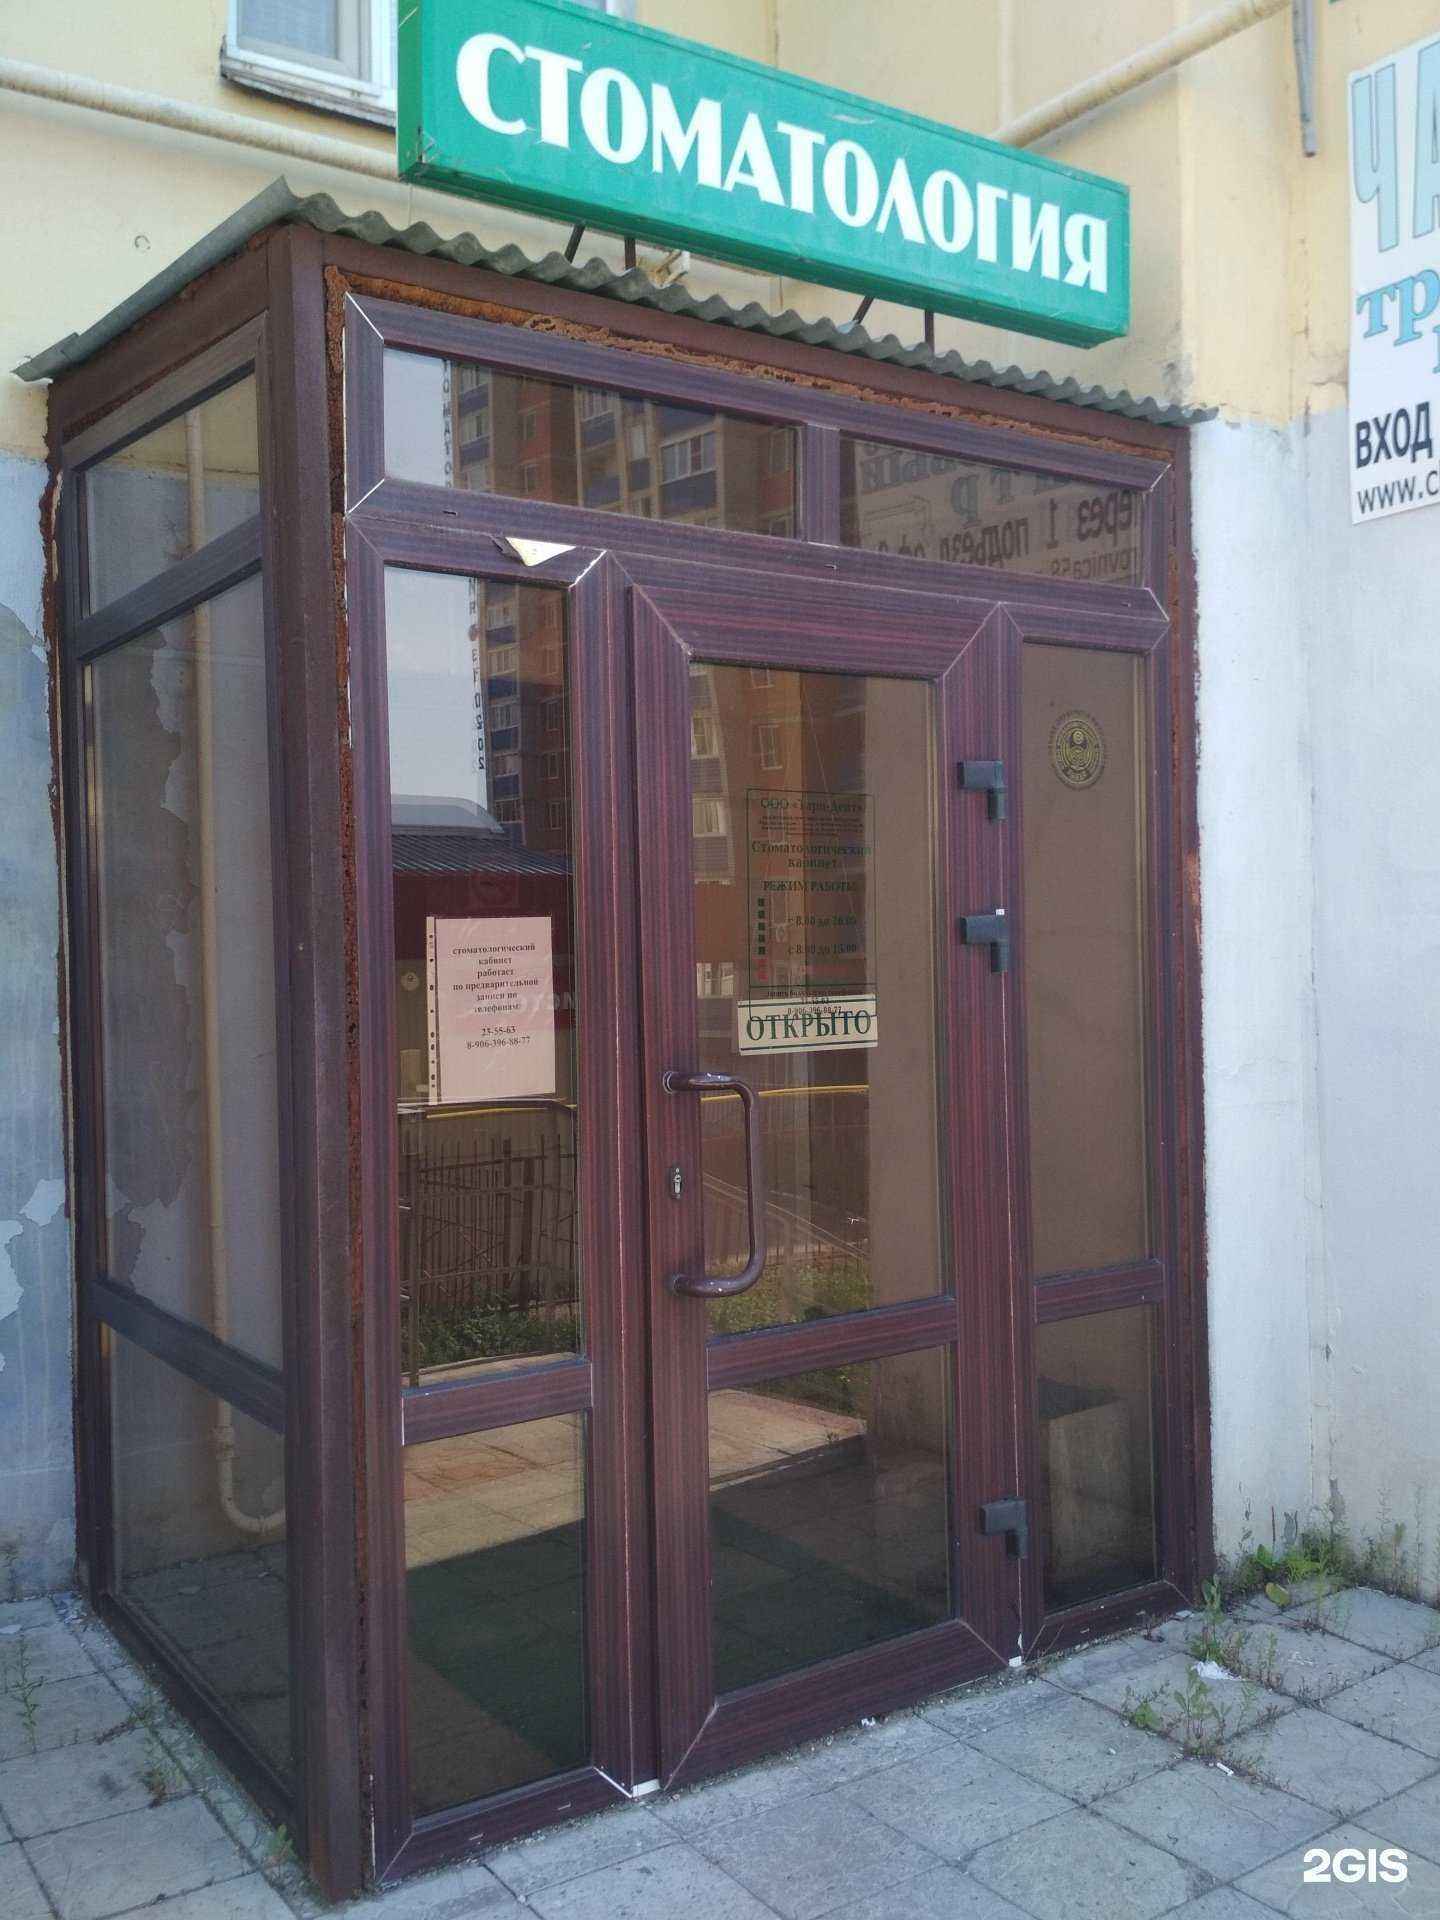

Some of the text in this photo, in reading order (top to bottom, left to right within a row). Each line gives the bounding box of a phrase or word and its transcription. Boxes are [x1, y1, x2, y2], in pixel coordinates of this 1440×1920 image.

[456, 33, 1108, 292] СТОМАТОЛОГИЯ
[1356, 401, 1433, 469] ВХОД
[1357, 461, 1440, 514] www.c
[763, 881, 807, 892] РЕЖИМ
[452, 943, 536, 955] стоматологический
[478, 957, 513, 966] кабинет
[477, 968, 514, 980] работает
[465, 978, 539, 992] предварительной
[476, 993, 505, 1001] записи
[746, 1010, 872, 1041] ОТКРЫТО
